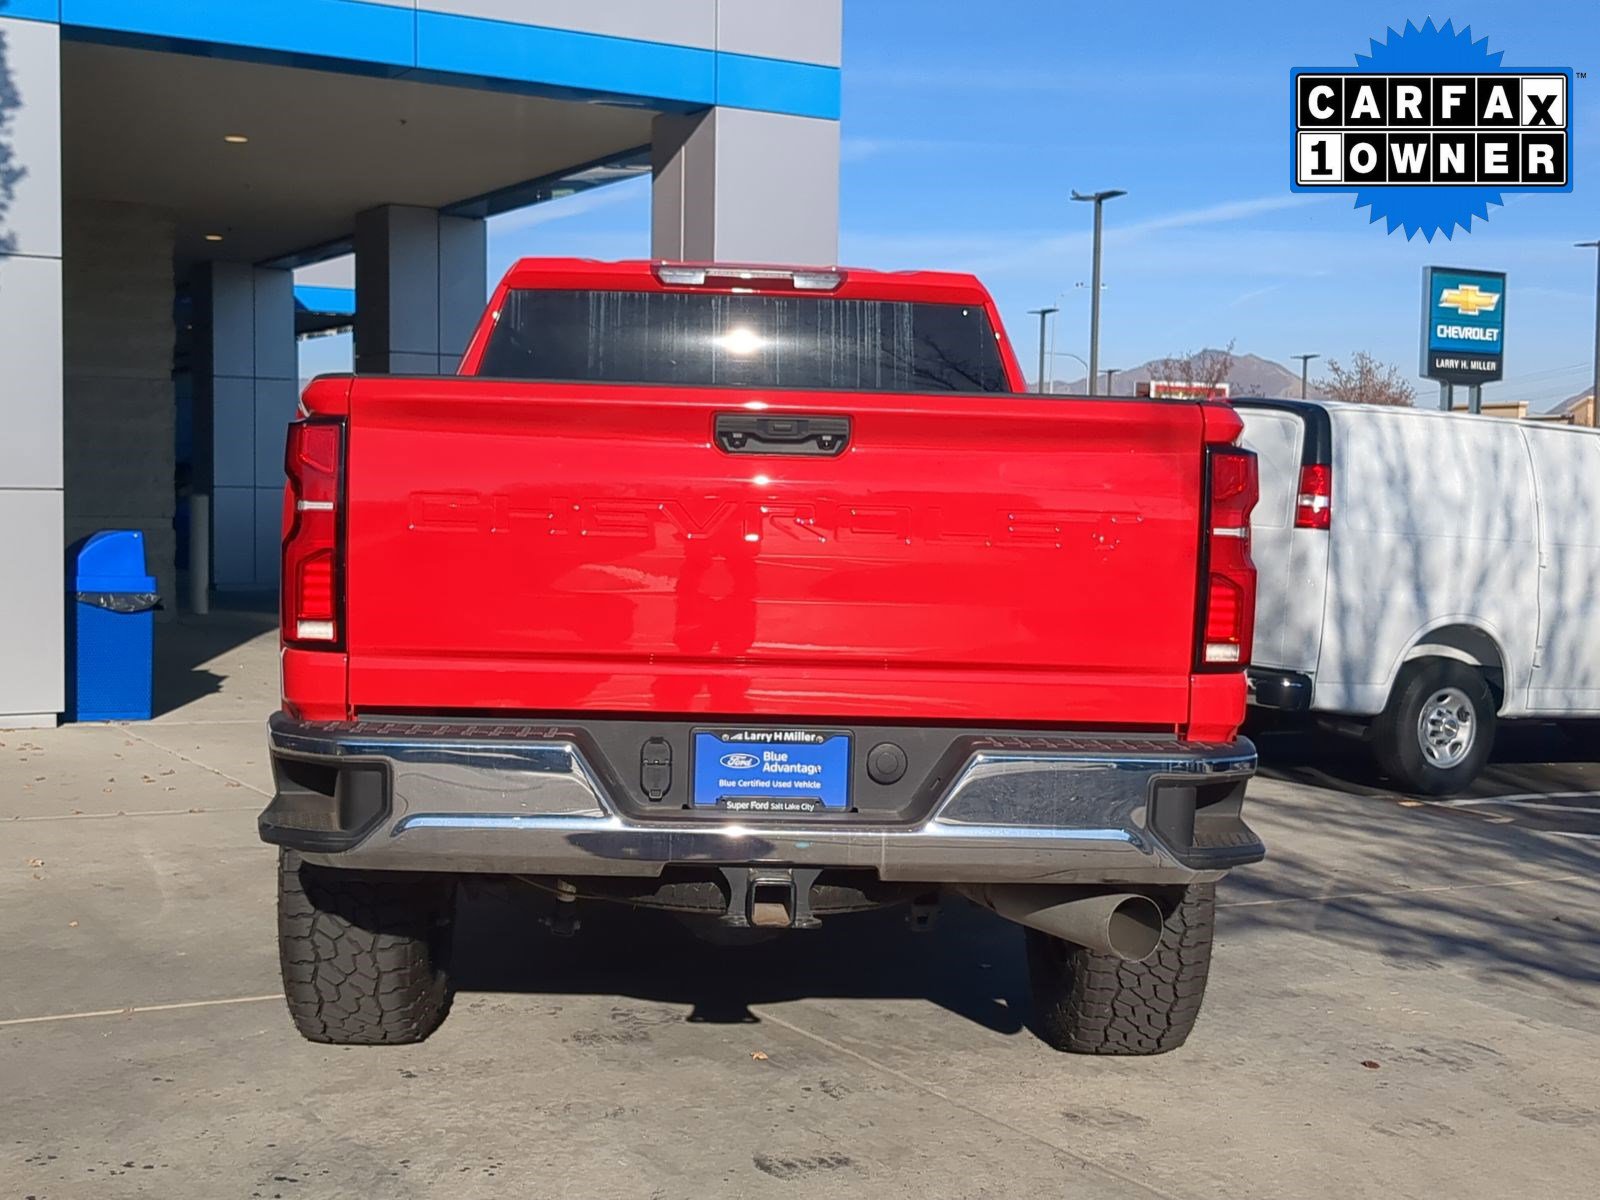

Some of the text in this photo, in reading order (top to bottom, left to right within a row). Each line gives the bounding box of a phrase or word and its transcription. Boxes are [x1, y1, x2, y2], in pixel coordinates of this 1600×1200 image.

[1437, 325, 1499, 341] CHEVROLET
[1435, 358, 1496, 371] LARRY H. MILLER
[744, 731, 816, 743] Larry H Miller
[763, 751, 788, 762] Blue
[762, 762, 822, 775] Advantage
[718, 778, 821, 789] Blue Certified Used Vehicle
[726, 800, 815, 812] Super Ford Salt Lake City
